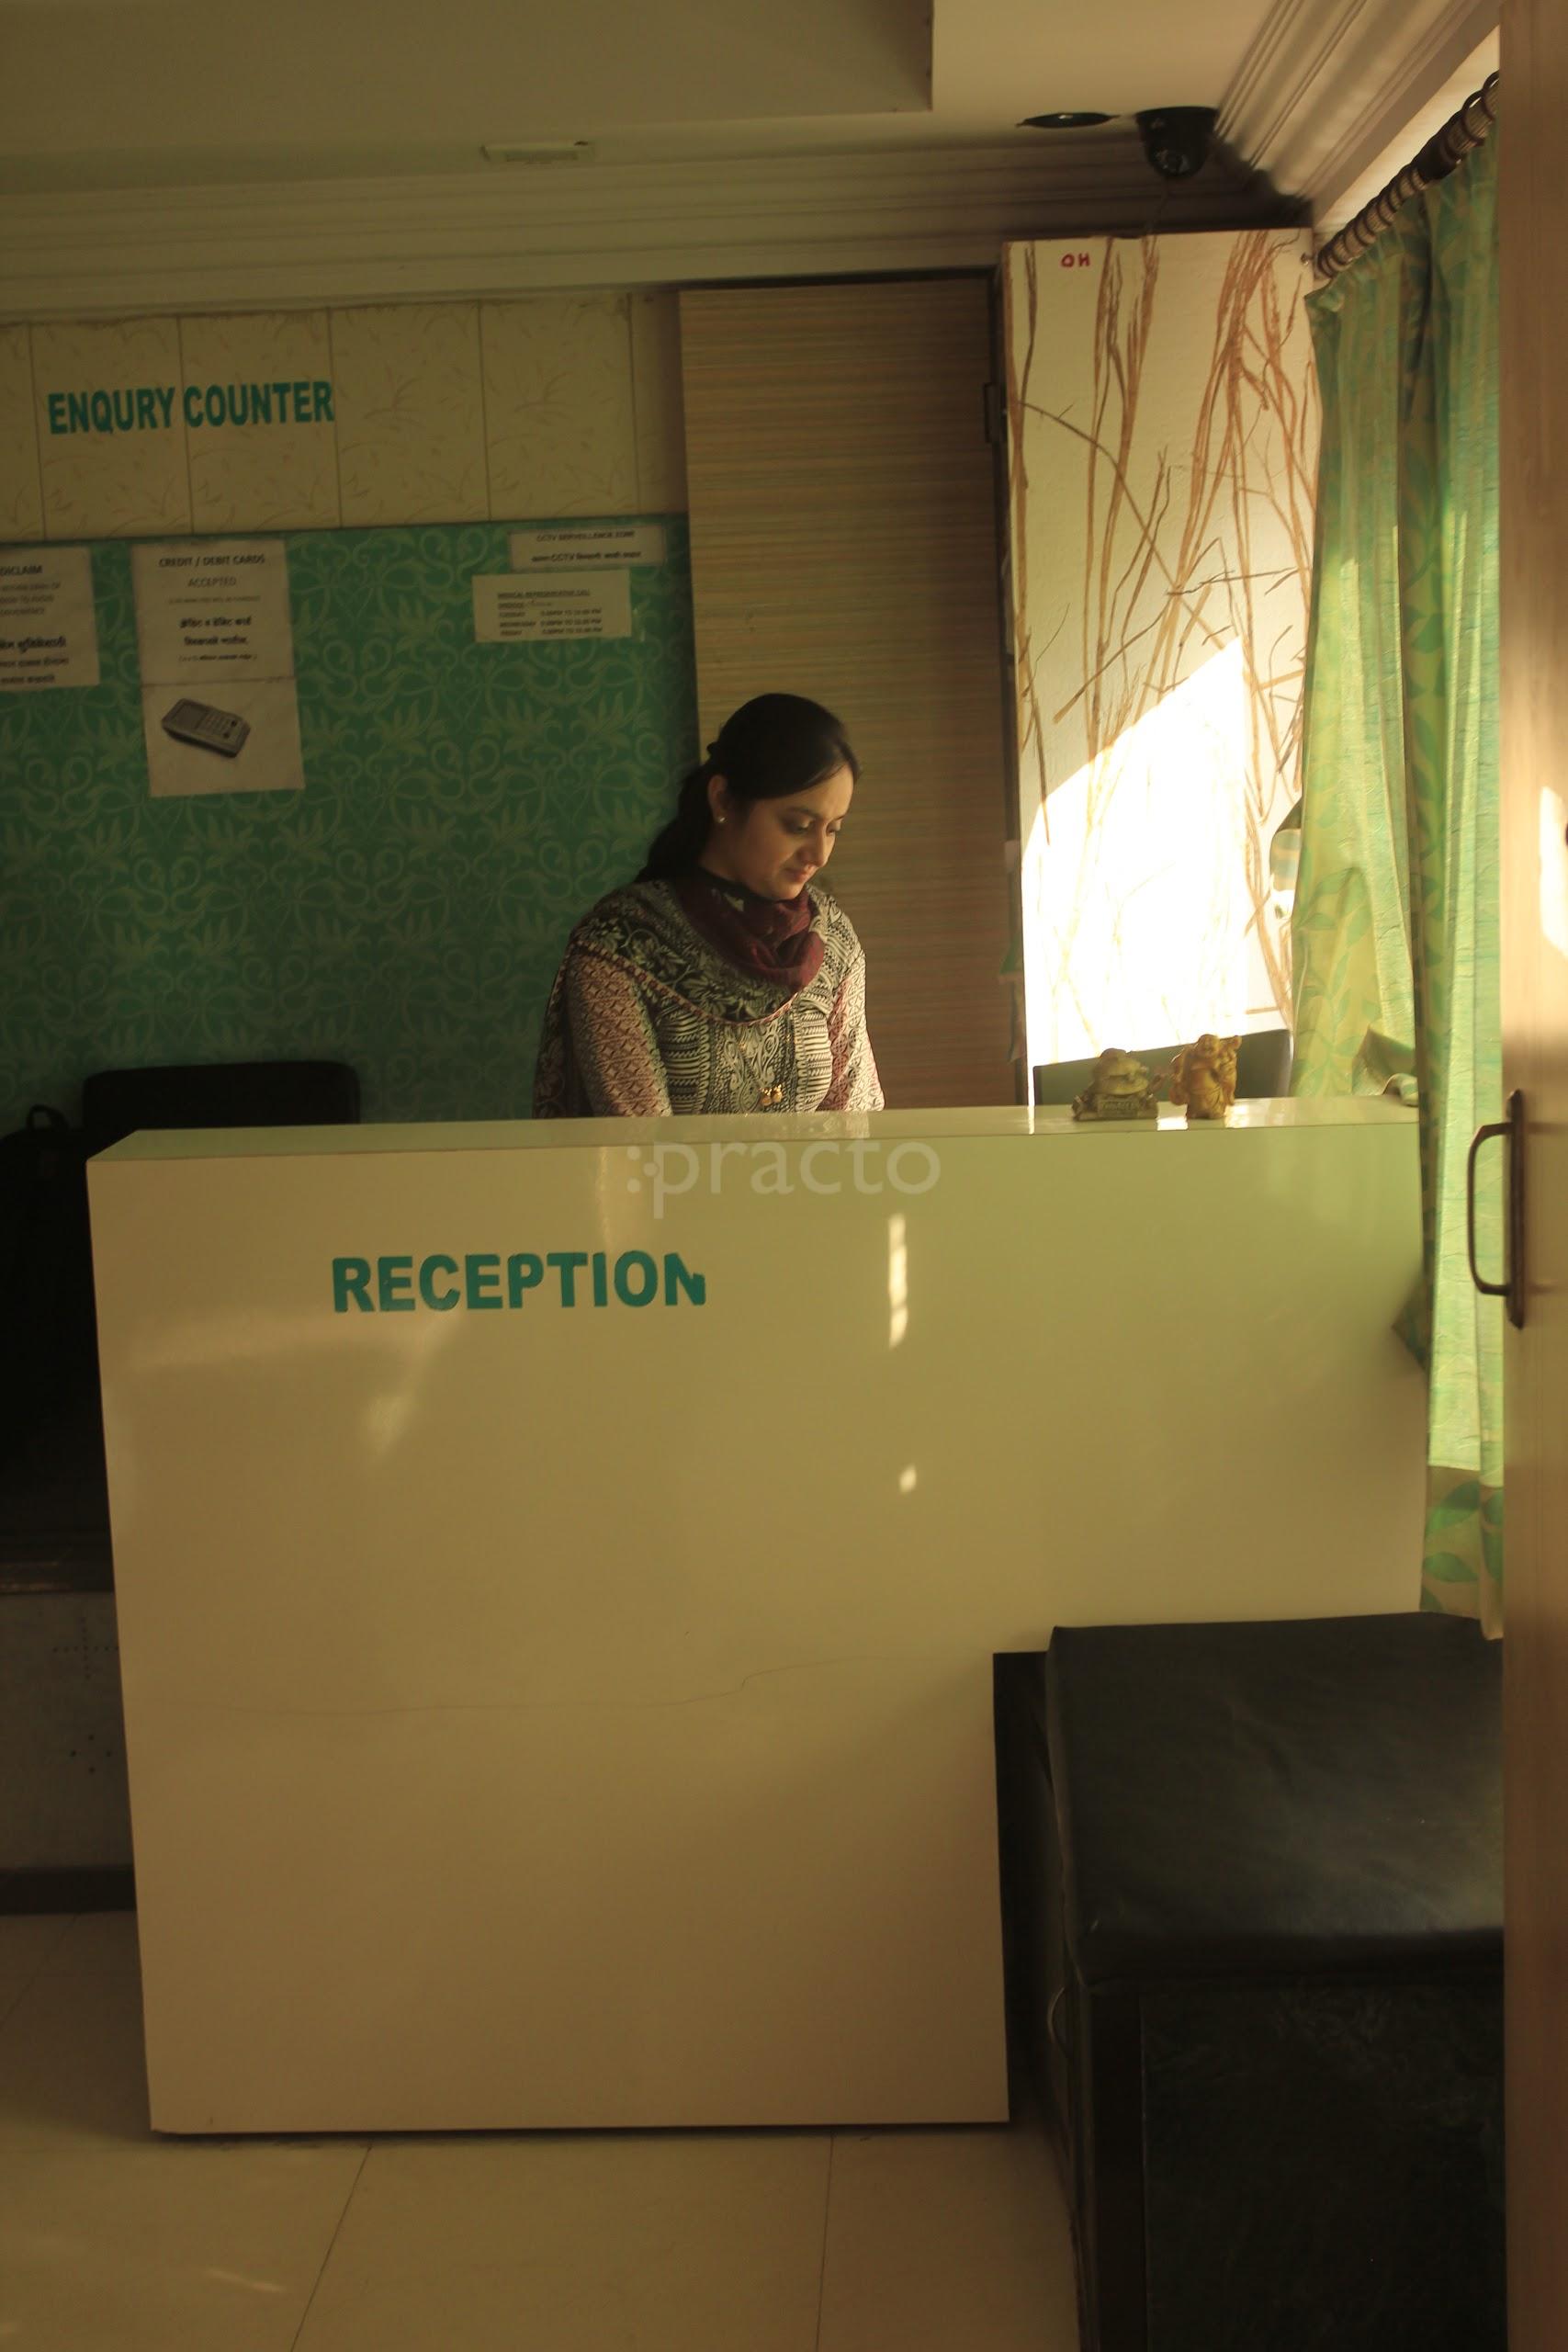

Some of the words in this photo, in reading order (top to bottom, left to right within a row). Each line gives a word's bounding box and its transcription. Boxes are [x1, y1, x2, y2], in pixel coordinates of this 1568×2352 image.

[48, 386, 175, 435] ENQURY
[183, 380, 335, 428] COUNTER
[158, 557, 192, 568] CREDIT
[202, 555, 230, 566] DEBIT
[232, 553, 266, 565] CARDS
[187, 575, 237, 588] ACCEPTED
[332, 1250, 706, 1313] RECEPTION
